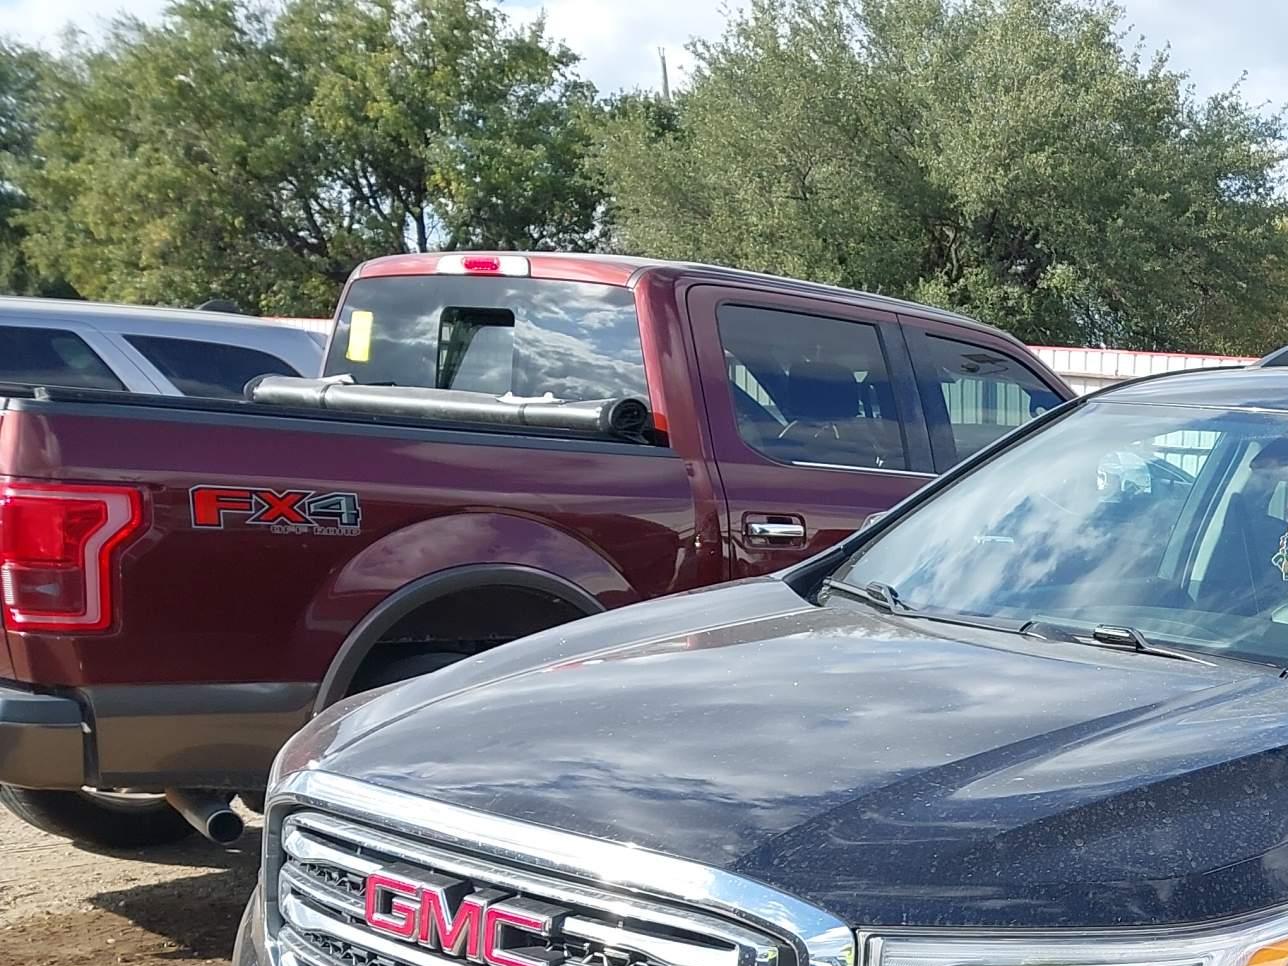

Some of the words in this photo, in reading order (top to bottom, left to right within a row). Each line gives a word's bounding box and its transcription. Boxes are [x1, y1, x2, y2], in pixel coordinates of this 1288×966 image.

[189, 485, 362, 529] FX4
[270, 525, 308, 534] OFF
[313, 526, 361, 536] ROAD
